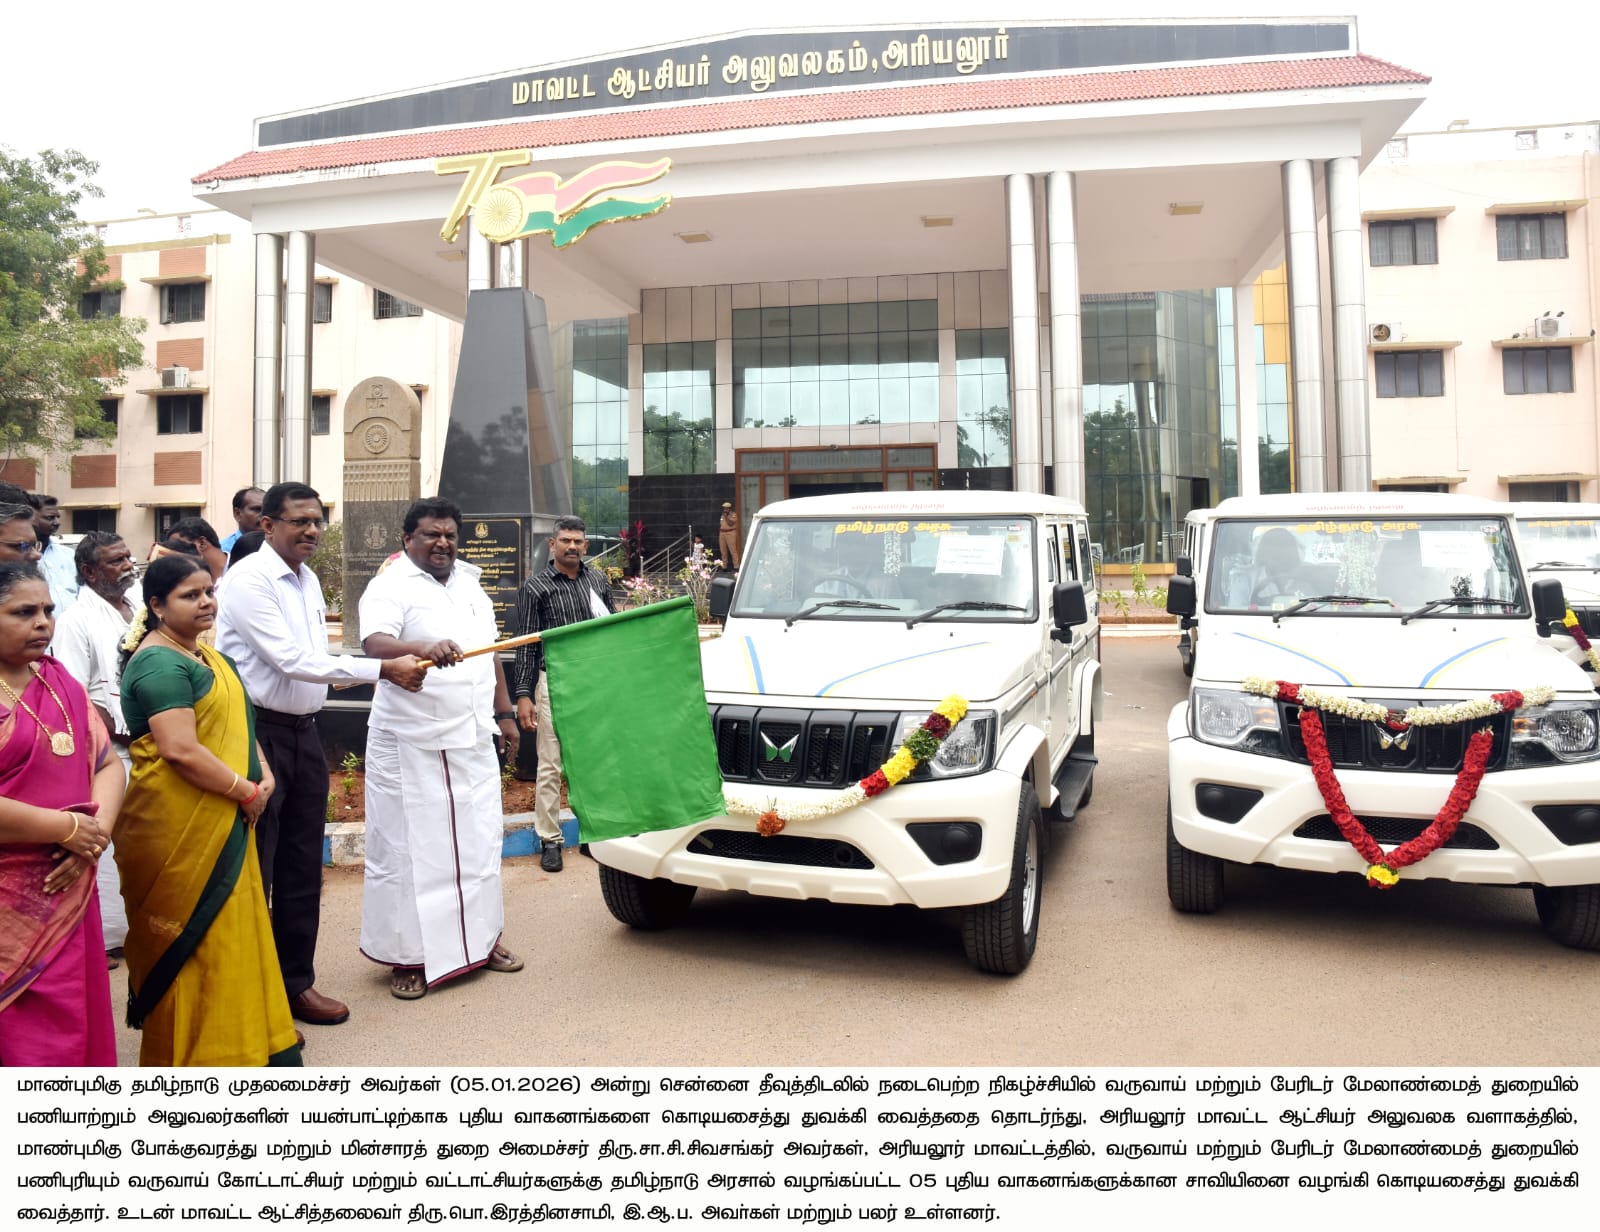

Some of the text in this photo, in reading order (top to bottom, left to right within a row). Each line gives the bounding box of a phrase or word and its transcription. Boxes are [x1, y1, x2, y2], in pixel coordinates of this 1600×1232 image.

[511, 77, 596, 105] மாவட்ட
[607, 54, 711, 99] ஆட்சியர்
[834, 521, 909, 534] தமிழ்நாடு
